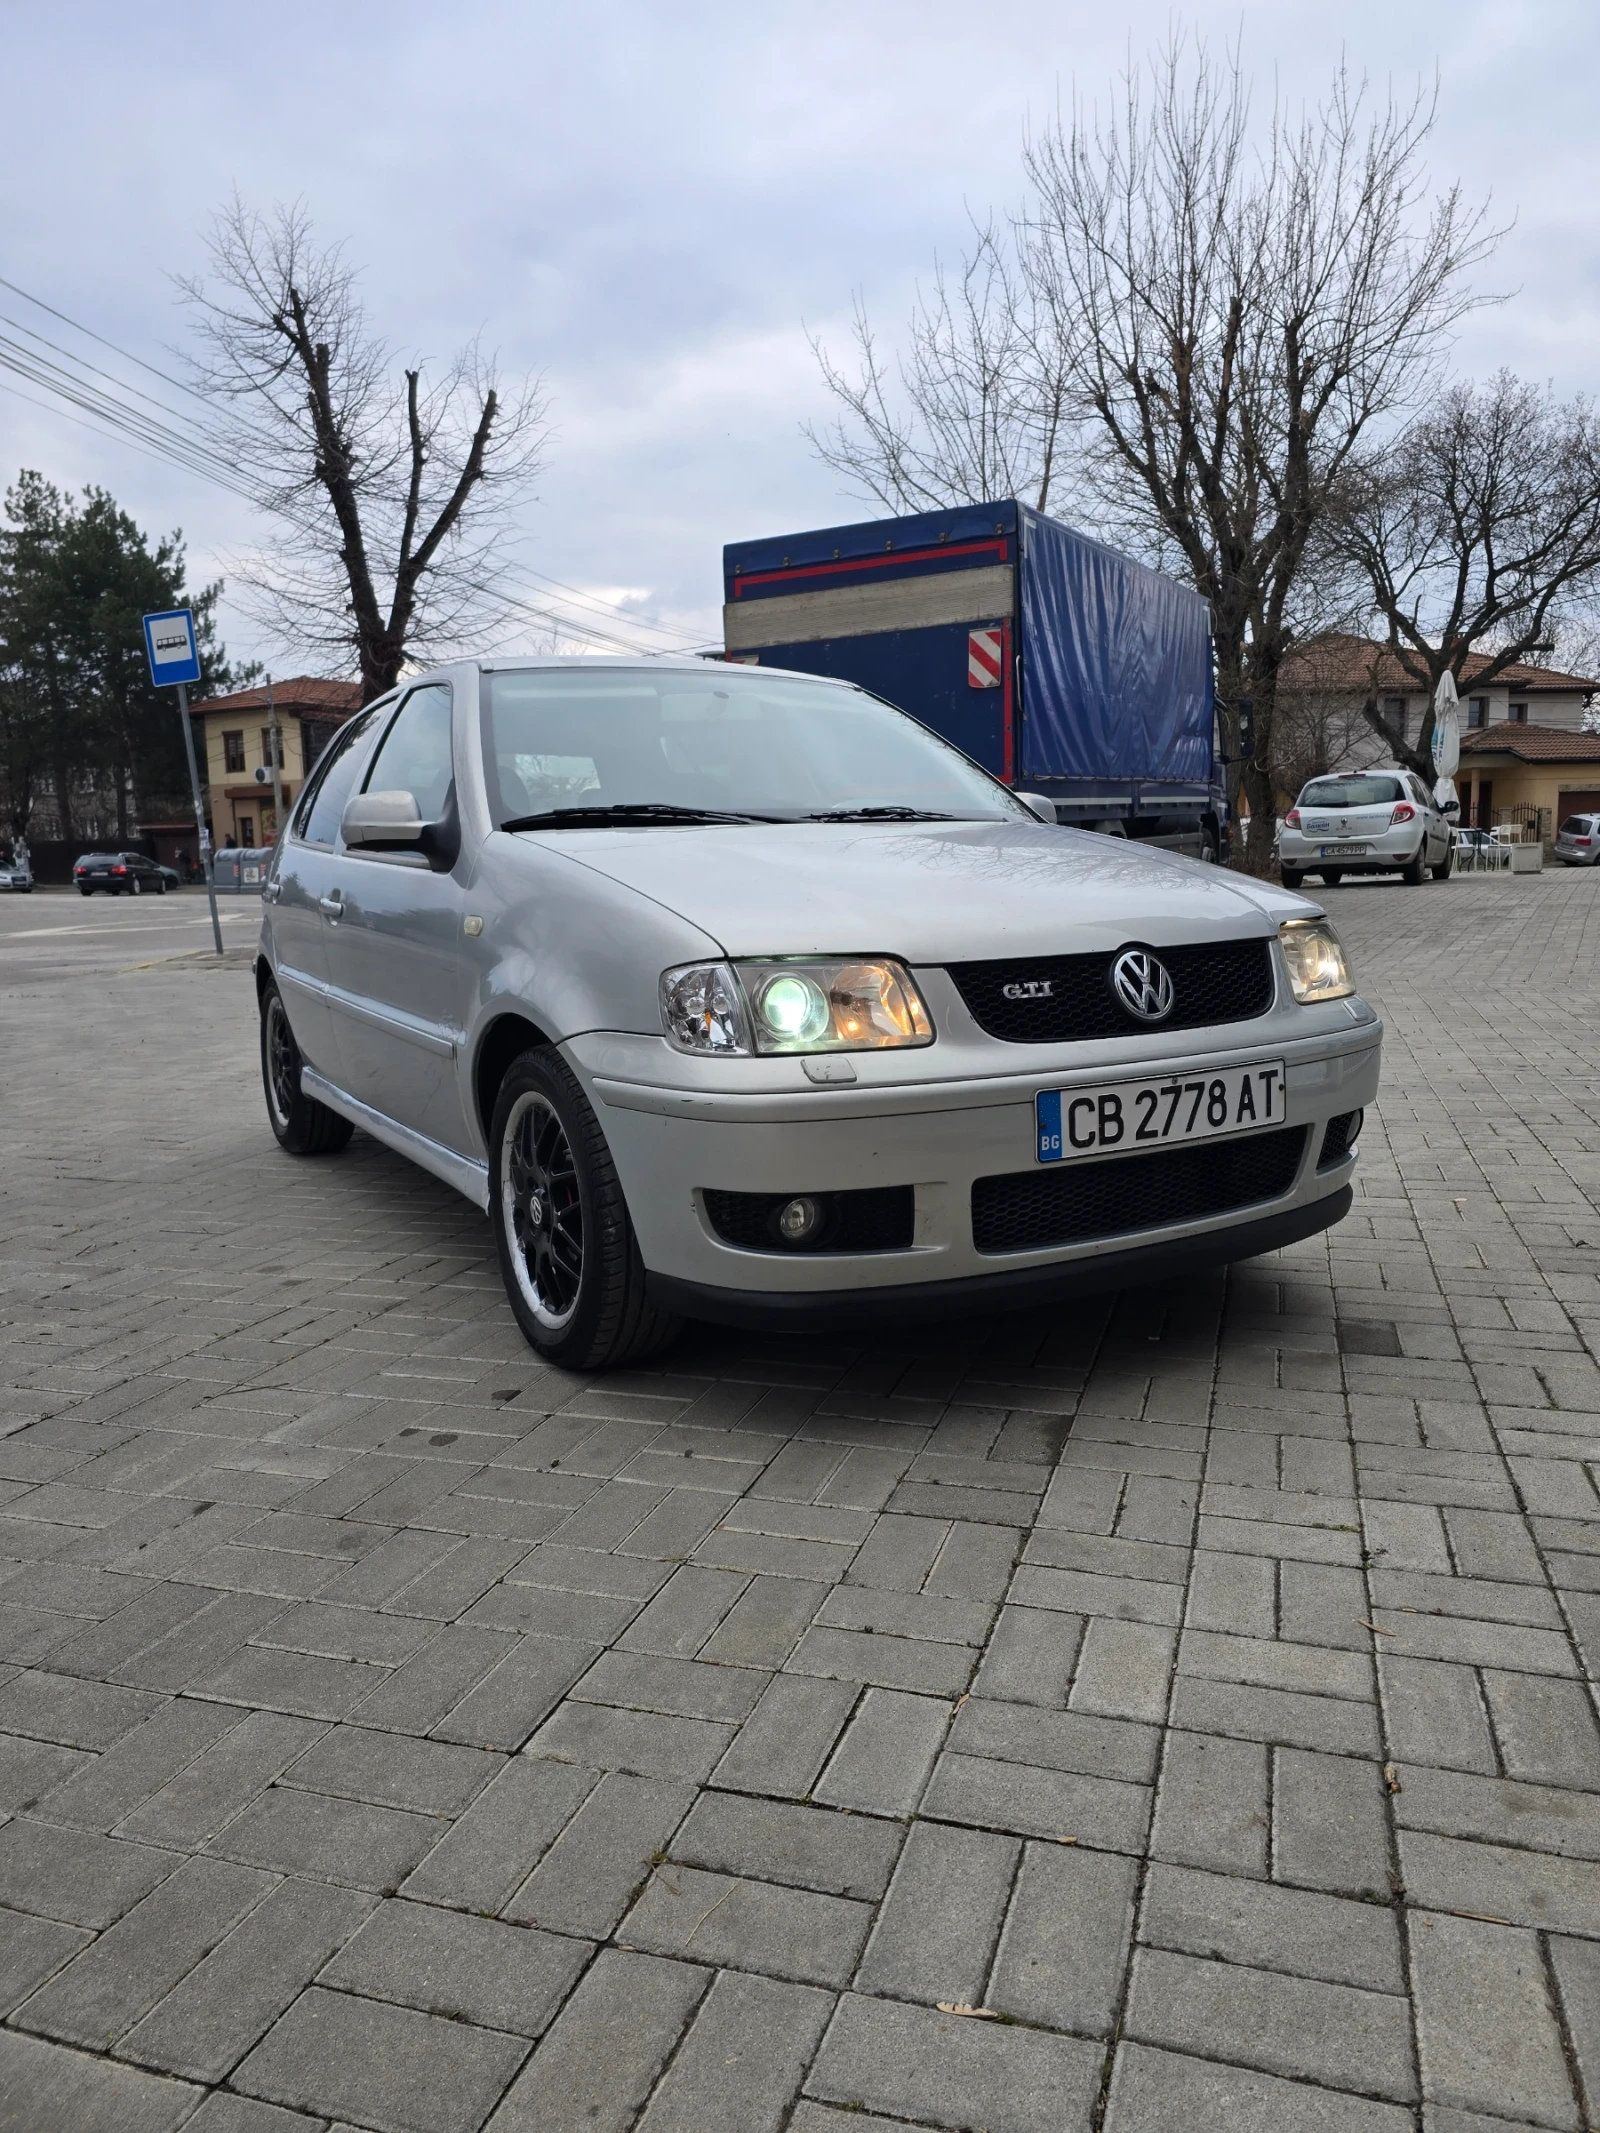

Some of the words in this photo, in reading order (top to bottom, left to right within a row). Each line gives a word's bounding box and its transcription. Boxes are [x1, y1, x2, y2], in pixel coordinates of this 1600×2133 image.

[1326, 847, 1336, 855] CA
[1355, 845, 1365, 853] PP
[1002, 981, 1054, 1000] GTI
[1068, 1093, 1124, 1149] CB
[1135, 1079, 1228, 1140] 2778
[1236, 1069, 1279, 1123] AT
[1041, 1135, 1060, 1151] BG
